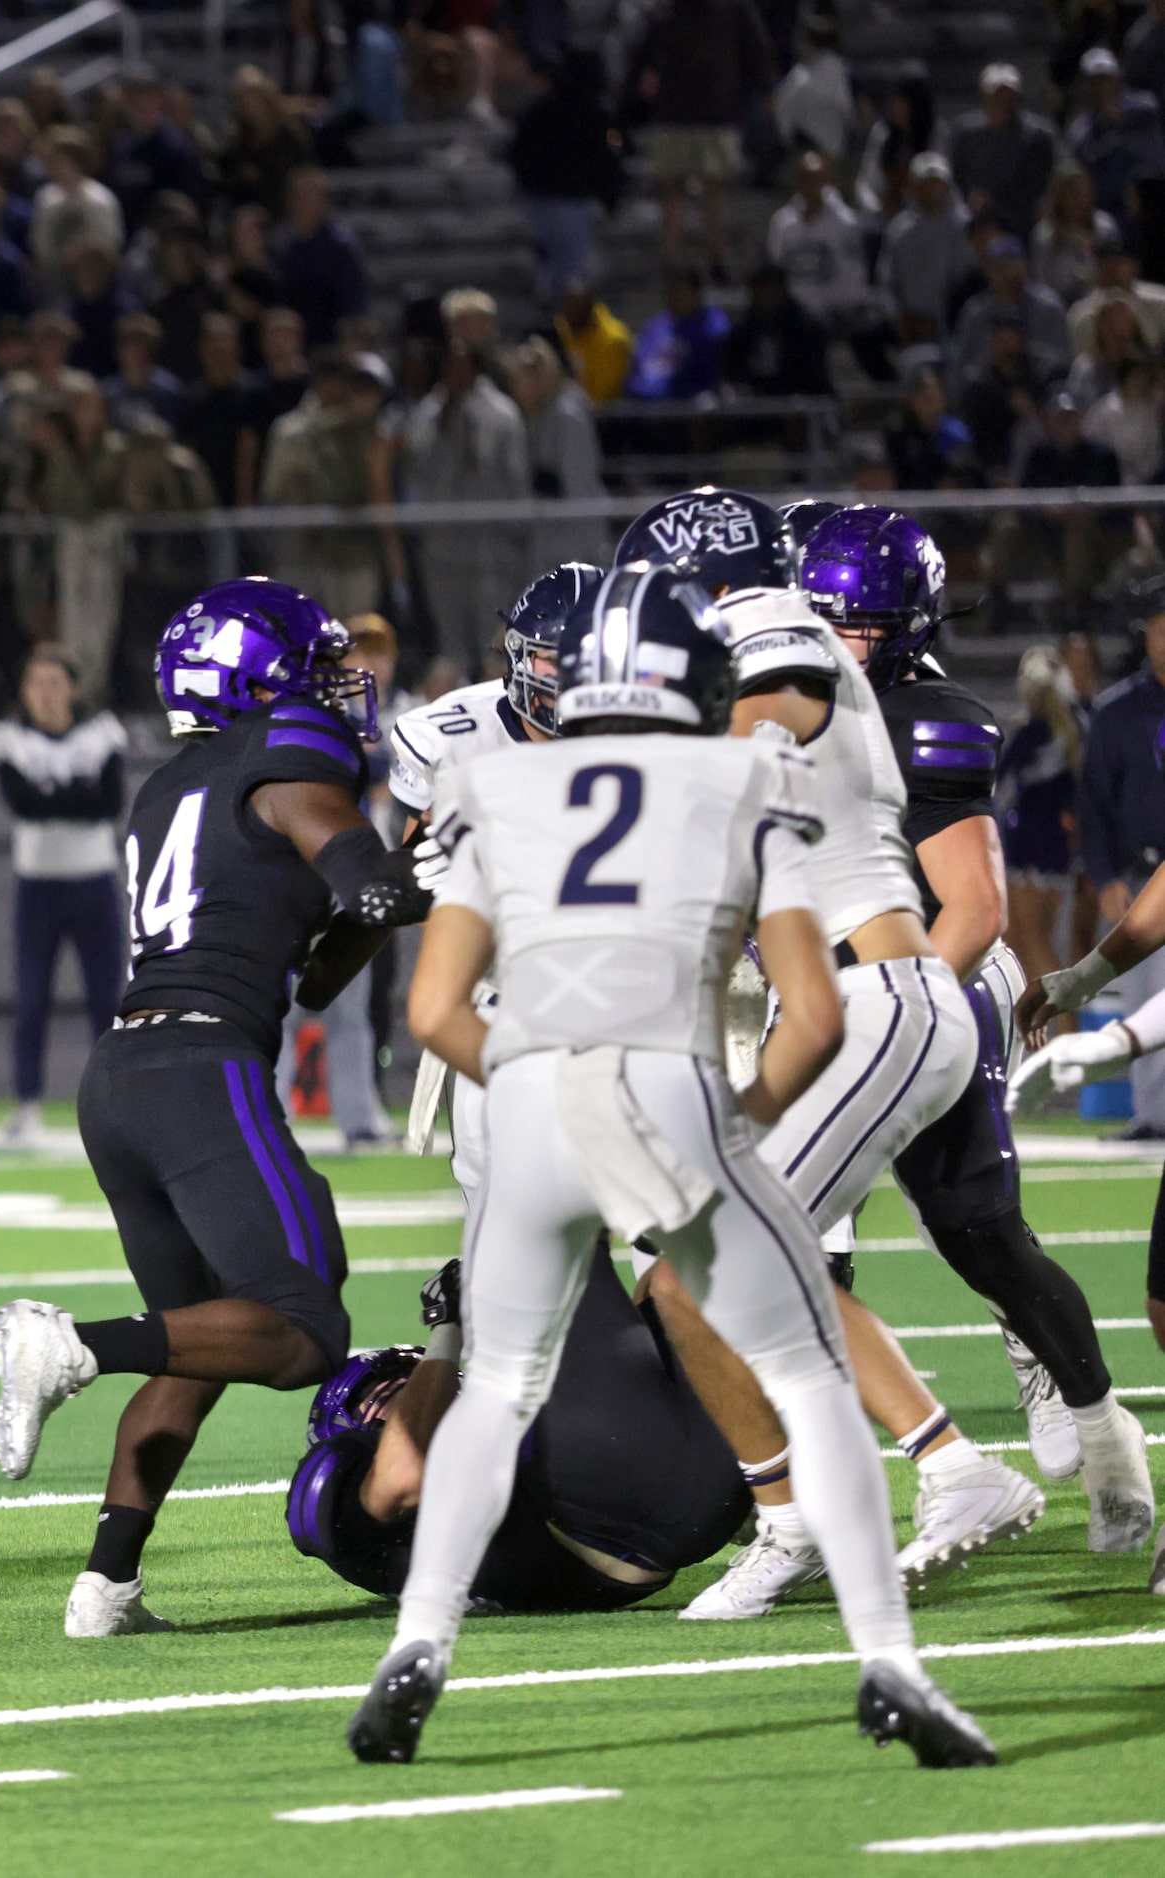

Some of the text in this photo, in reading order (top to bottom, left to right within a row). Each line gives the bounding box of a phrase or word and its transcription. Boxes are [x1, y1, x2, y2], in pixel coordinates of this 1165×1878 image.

[182, 615, 244, 669] 34
[427, 703, 478, 735] 70
[574, 689, 663, 711] WILDCATS
[558, 763, 643, 906] 2
